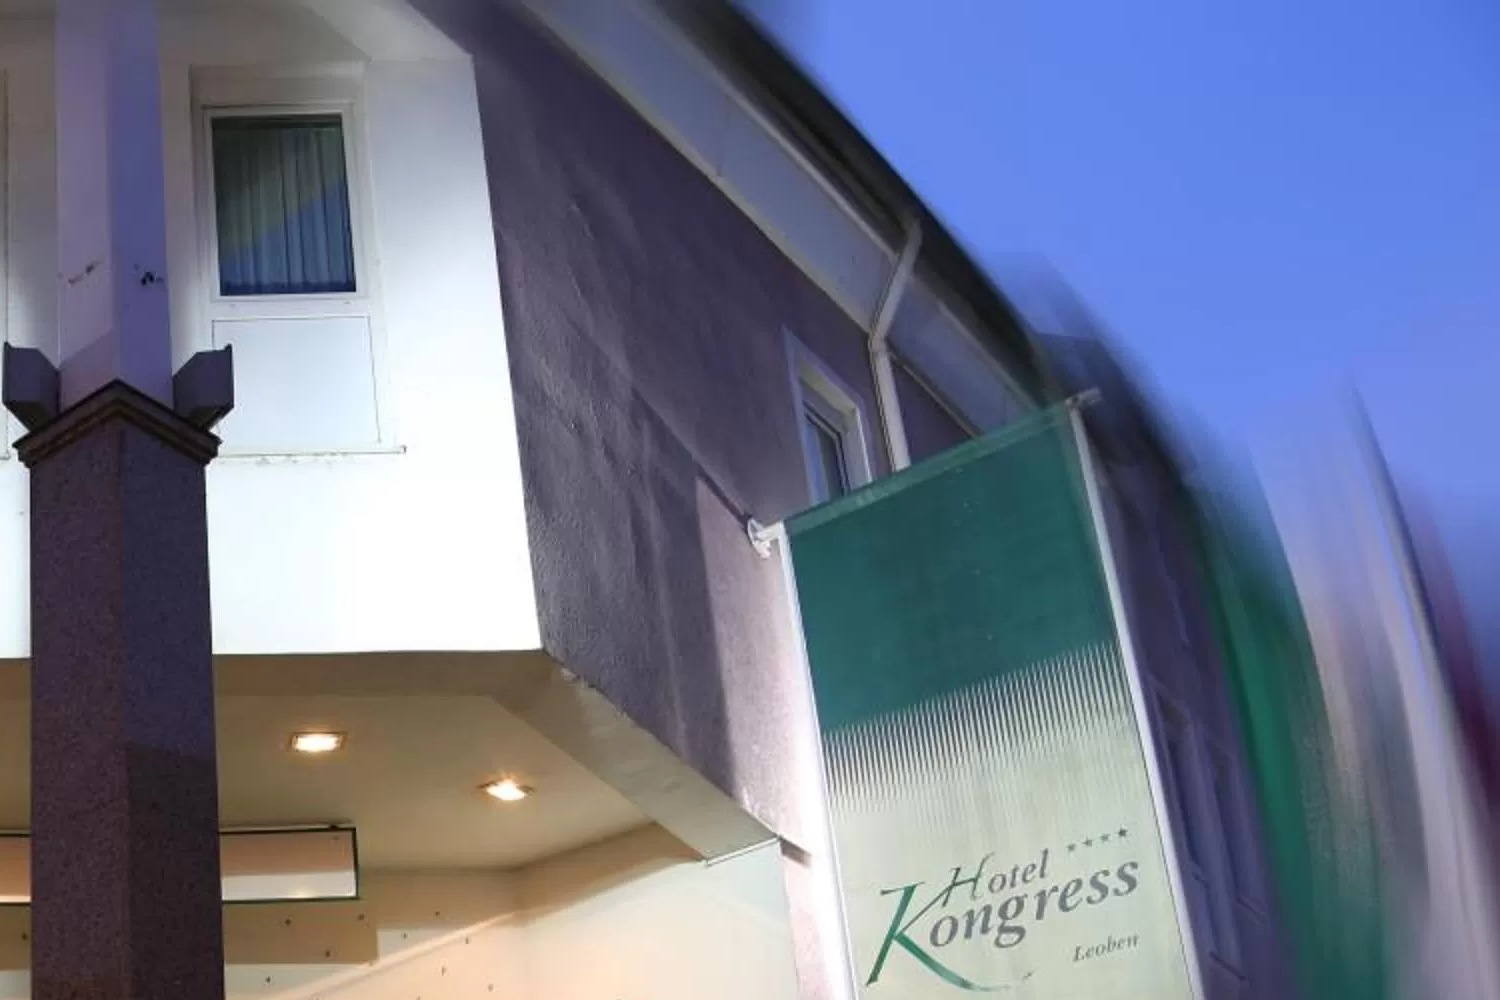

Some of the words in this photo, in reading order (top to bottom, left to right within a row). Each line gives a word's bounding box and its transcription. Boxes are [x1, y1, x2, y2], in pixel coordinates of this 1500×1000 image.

[941, 848, 1049, 907] Hotel
[866, 861, 1139, 991] Kongress
[1071, 934, 1138, 962] Leoben
